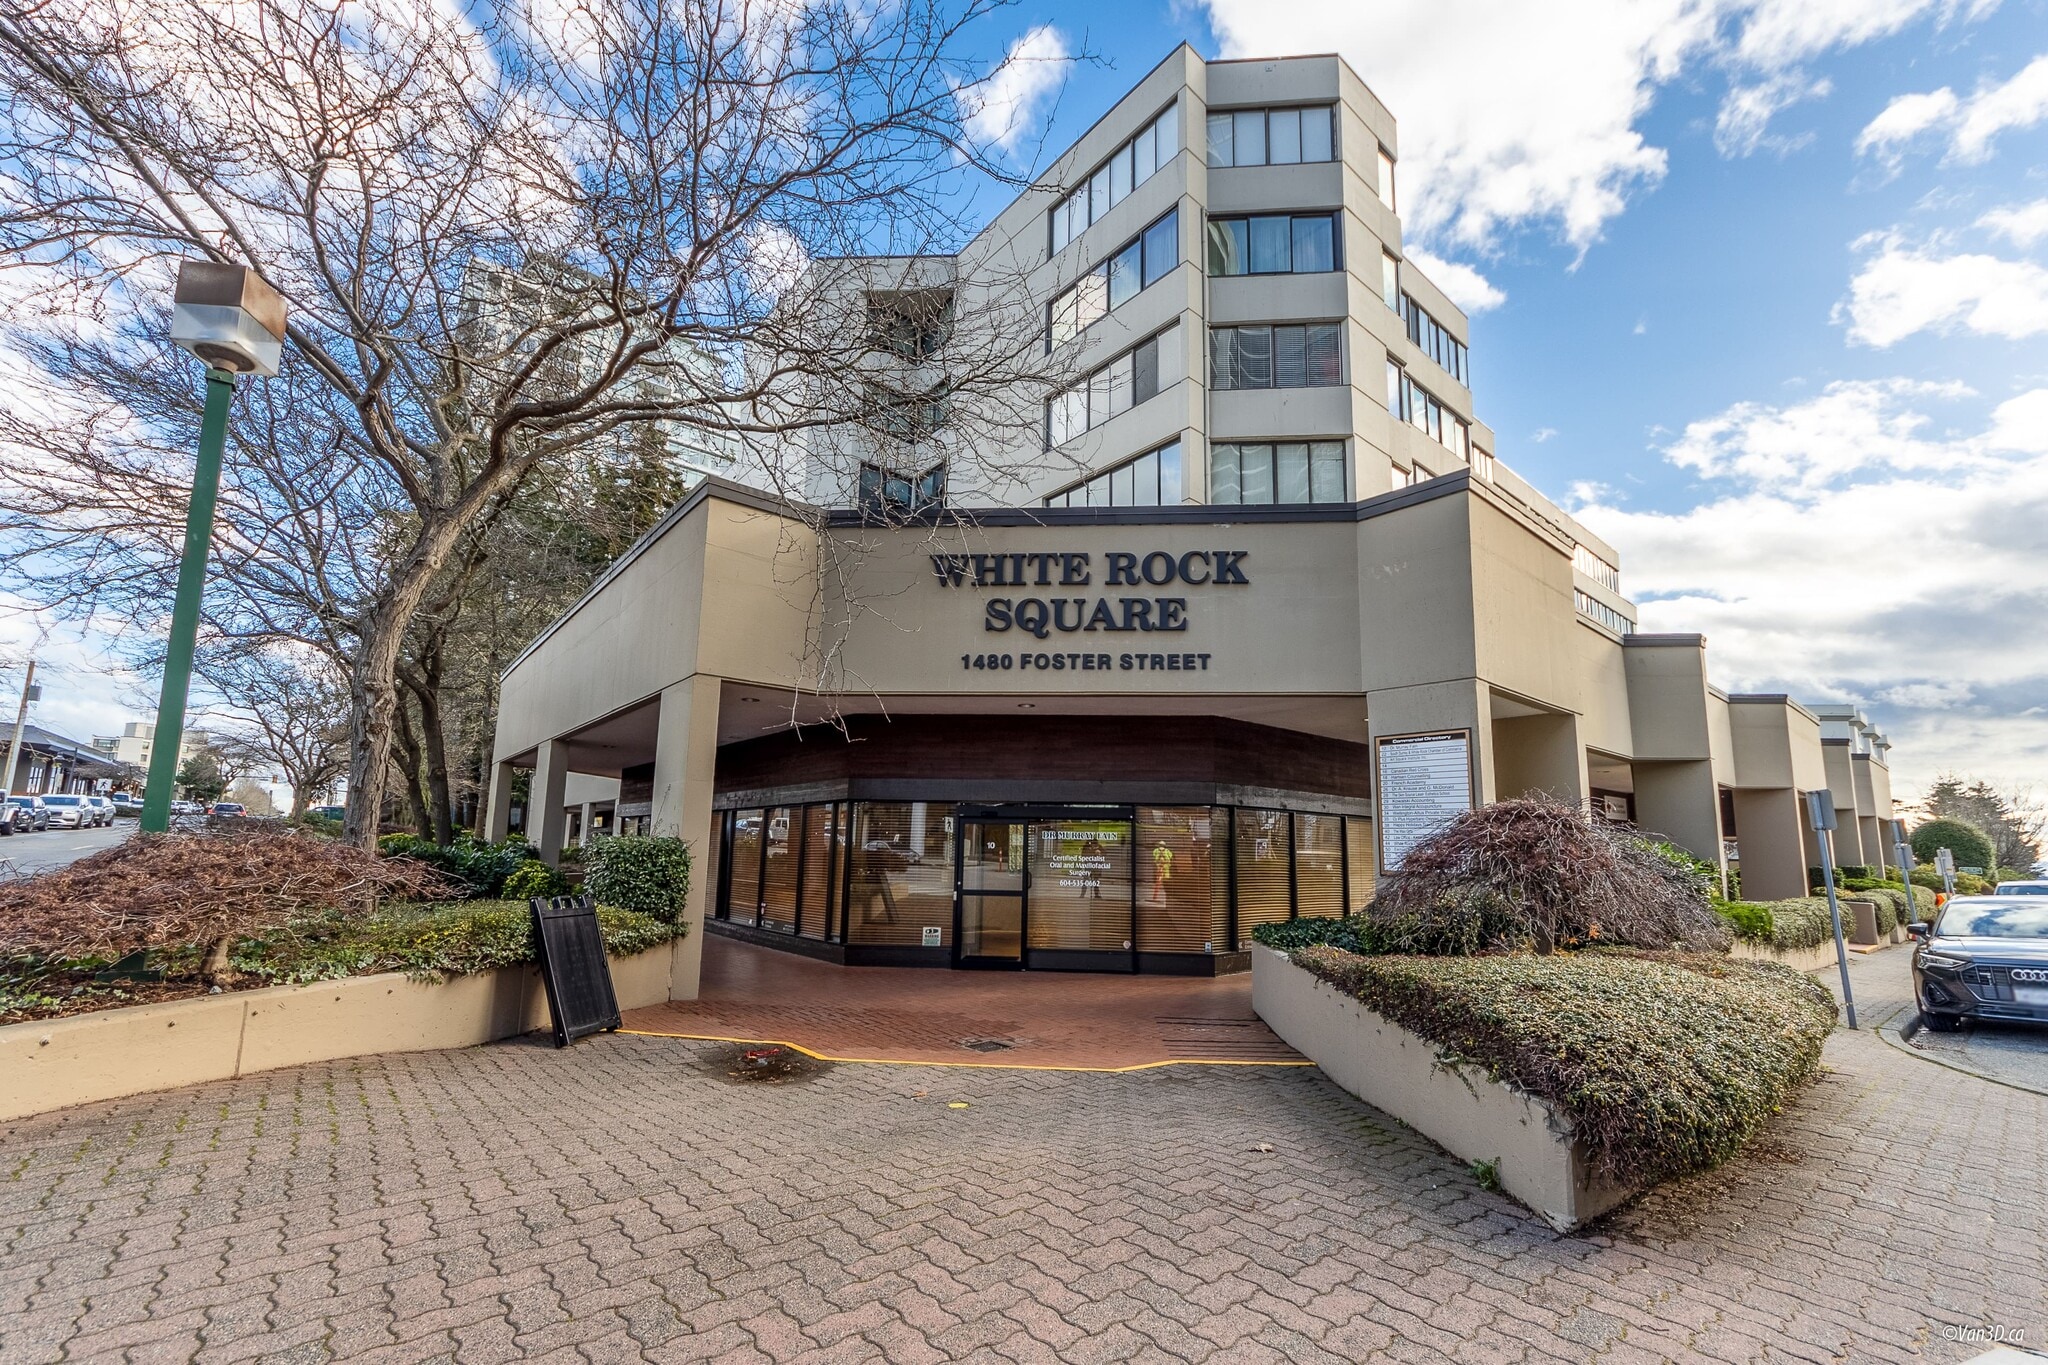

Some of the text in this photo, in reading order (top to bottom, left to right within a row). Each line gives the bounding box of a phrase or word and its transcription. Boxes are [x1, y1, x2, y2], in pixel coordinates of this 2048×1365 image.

[931, 551, 1249, 587] WHITE ROCK
[986, 598, 1187, 639] SQUARE
[962, 653, 1211, 670] 1480 FOSTER STREET
[1042, 831, 1056, 839] DR
[1058, 831, 1095, 840] MURRAY
